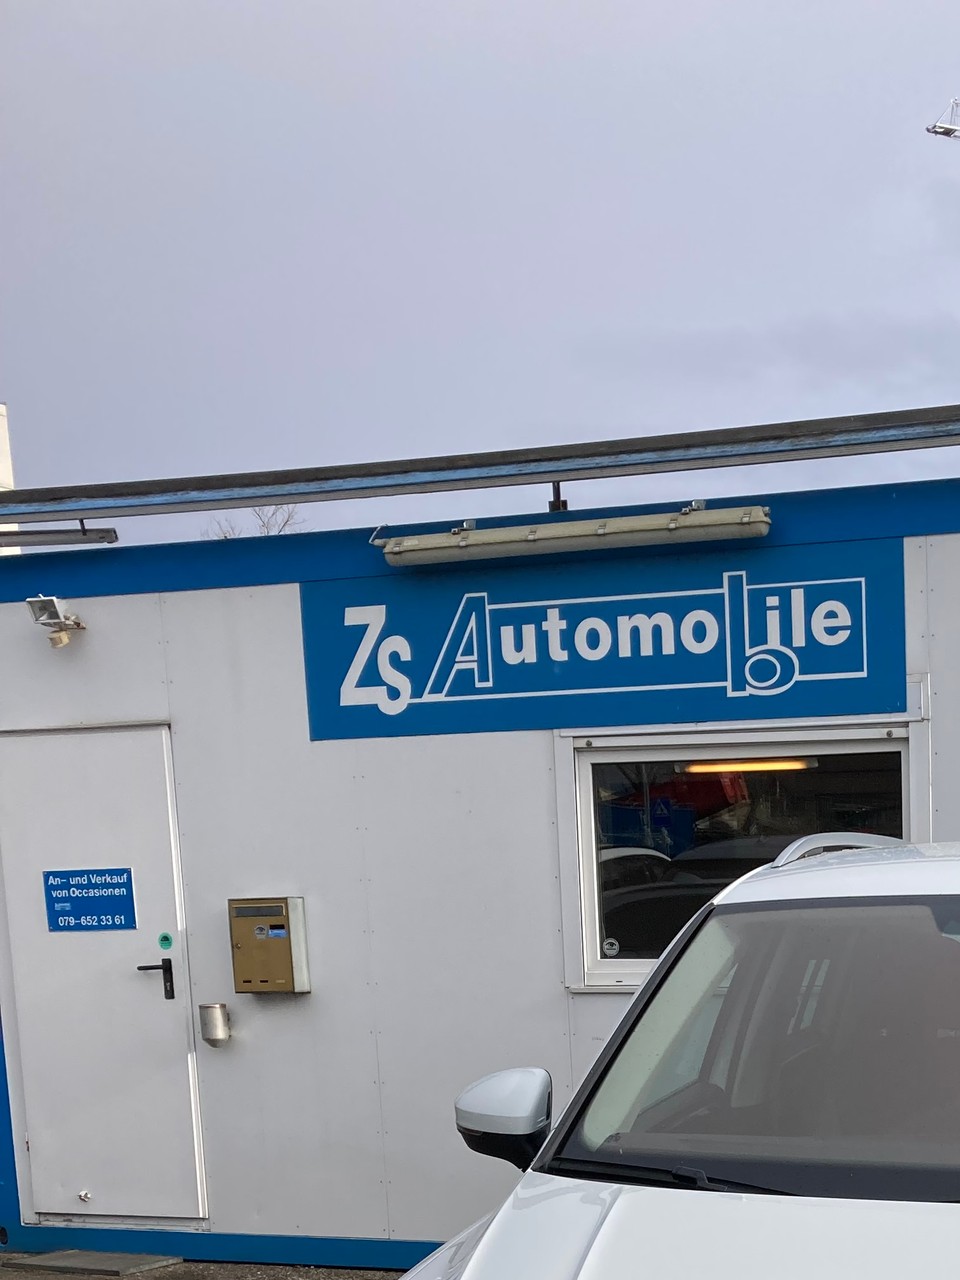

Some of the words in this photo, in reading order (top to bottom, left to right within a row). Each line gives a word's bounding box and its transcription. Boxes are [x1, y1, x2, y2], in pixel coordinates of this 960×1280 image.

[423, 571, 853, 698] Automobile
[48, 875, 67, 886] An-
[69, 874, 88, 885] und
[89, 872, 128, 884] Verkauf
[51, 889, 69, 898] von
[69, 886, 127, 897] Occasionen
[58, 915, 98, 926] 079-652
[100, 915, 112, 925] 33
[114, 914, 125, 925] 61
